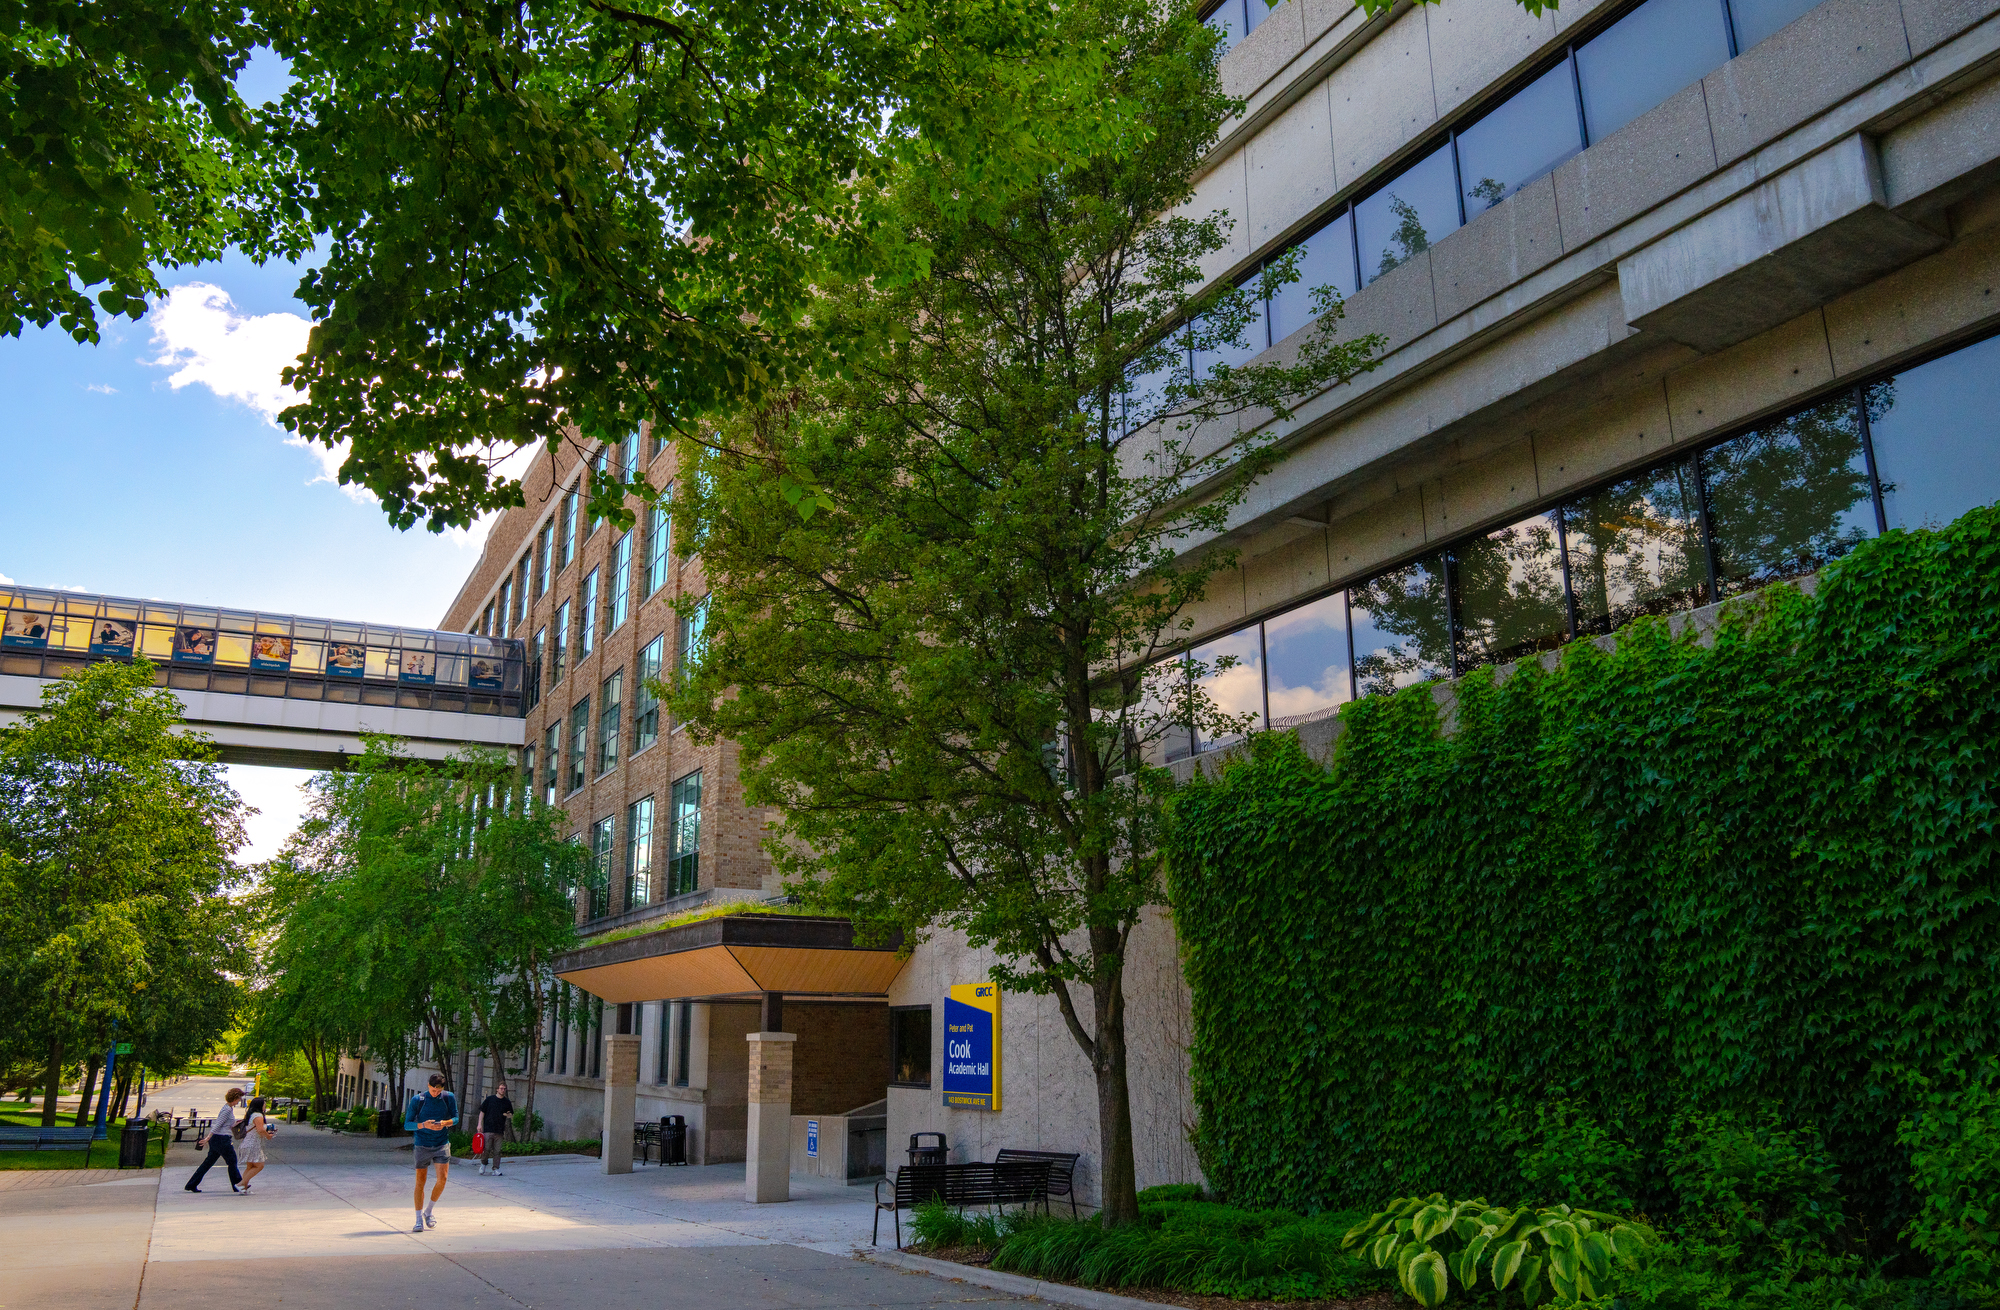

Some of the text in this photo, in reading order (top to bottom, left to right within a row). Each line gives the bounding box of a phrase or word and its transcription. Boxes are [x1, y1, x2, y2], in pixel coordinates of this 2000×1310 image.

[975, 986, 993, 997] GRCC
[949, 1023, 959, 1033] Peter
[949, 1039, 971, 1059] Cook
[948, 1062, 989, 1075] Academic Hall
[955, 1096, 973, 1105] BOSTWICK
[980, 1098, 986, 1106] NE
